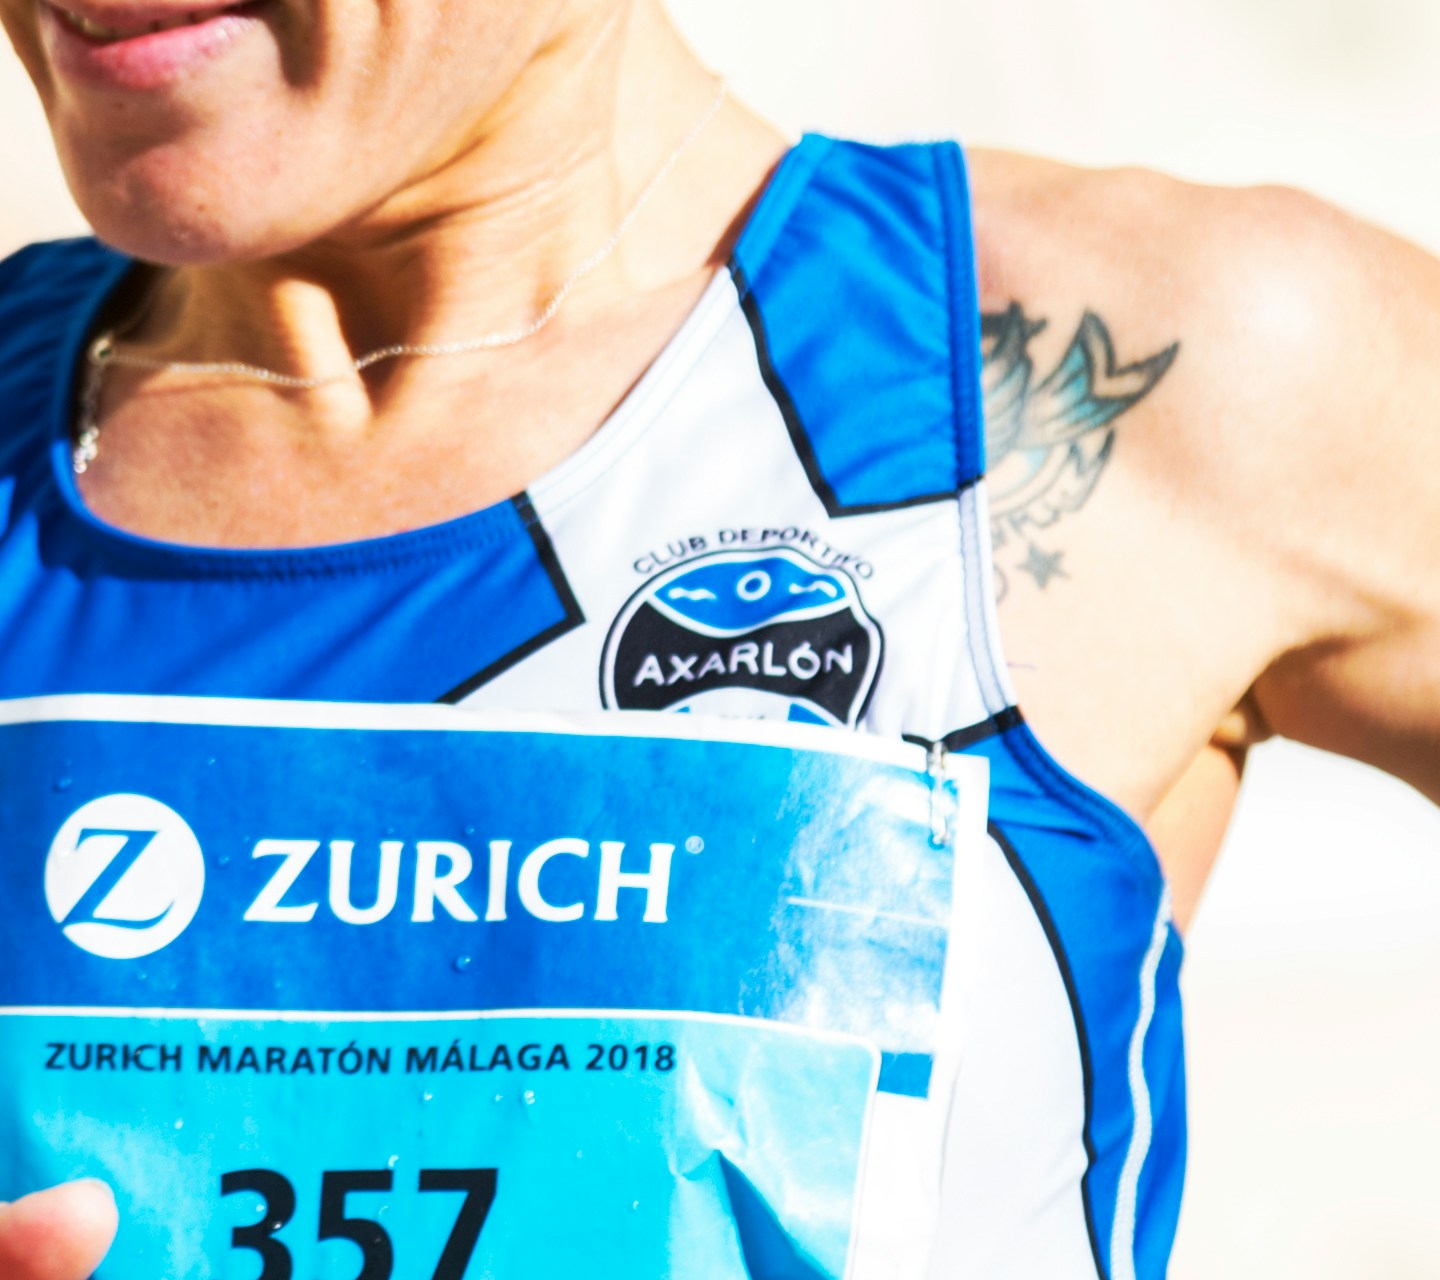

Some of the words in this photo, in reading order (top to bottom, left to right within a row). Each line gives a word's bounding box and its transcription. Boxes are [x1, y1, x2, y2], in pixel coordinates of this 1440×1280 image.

[632, 533, 709, 576] CLUB
[717, 525, 876, 581] DEPORTIVO
[633, 639, 855, 688] AXARLÓN
[45, 1041, 183, 1073] ZURICH
[197, 1039, 391, 1075] MARATÓN
[405, 1038, 570, 1074] MÁLAGA
[585, 1043, 676, 1073] 2018
